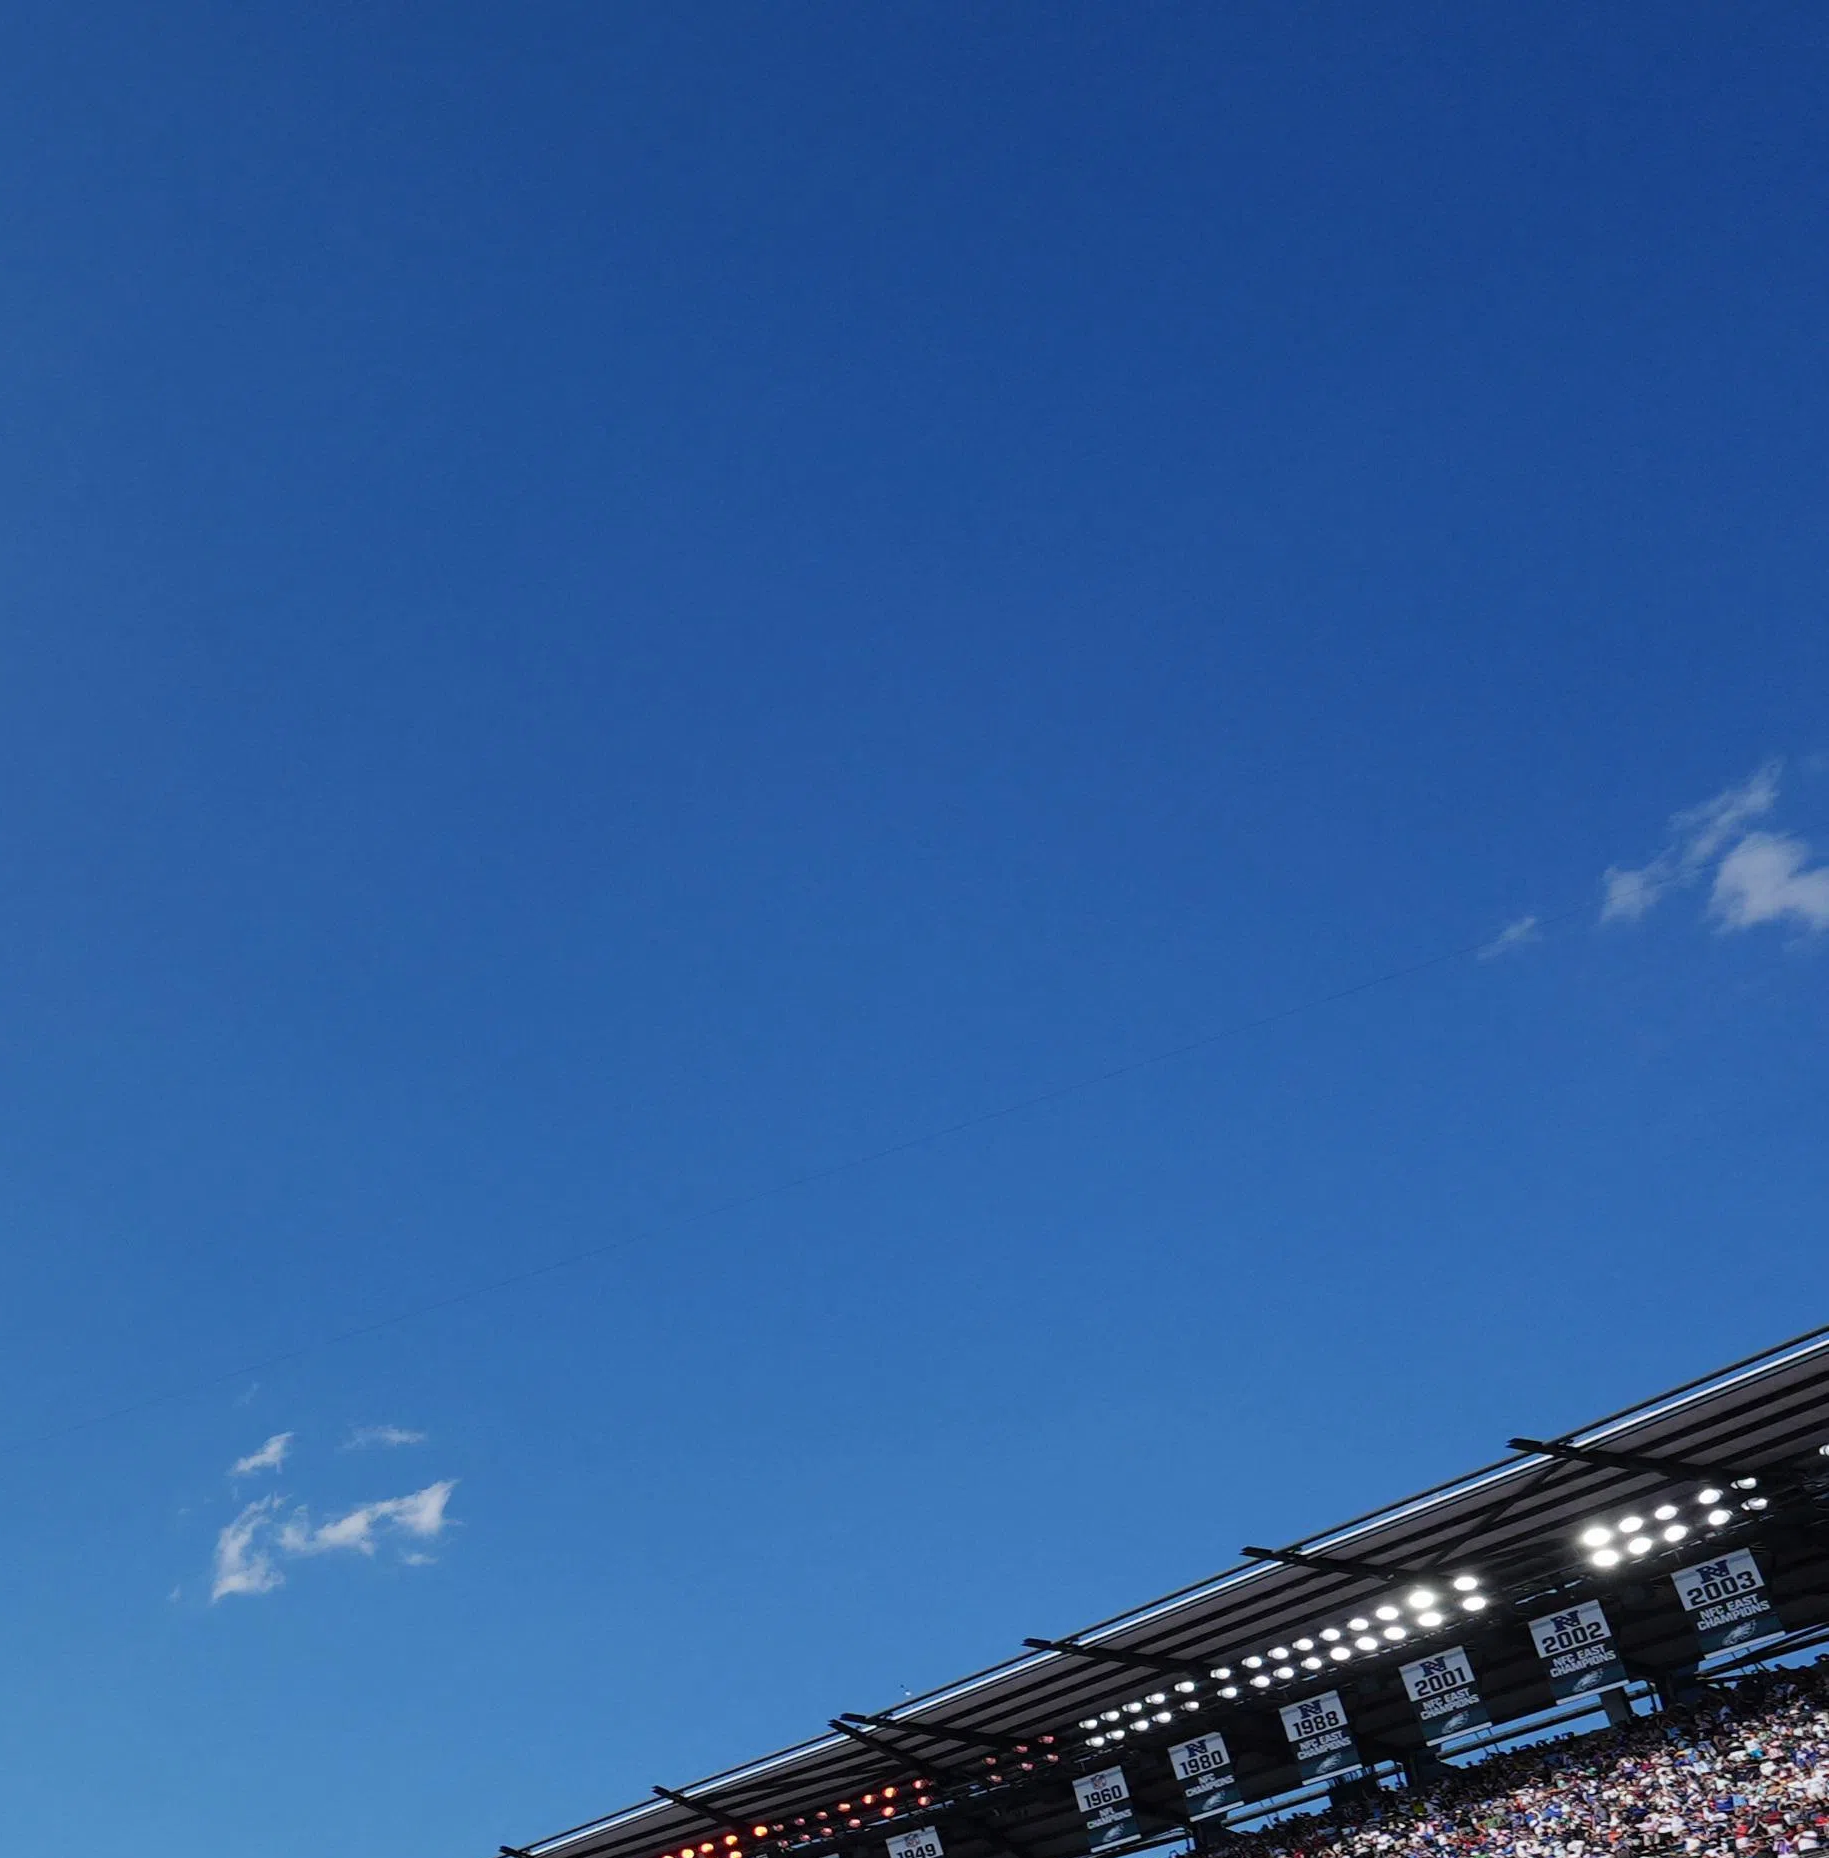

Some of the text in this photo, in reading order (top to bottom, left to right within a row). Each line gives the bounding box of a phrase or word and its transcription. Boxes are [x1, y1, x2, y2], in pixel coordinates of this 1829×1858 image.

[1686, 1570, 1757, 1606] 2003
[1697, 1600, 1771, 1631] CHAMPIONS
[1699, 1593, 1760, 1620] NFC EAST
[1542, 1622, 1606, 1653] 2002
[1549, 1650, 1617, 1678] CHAMPIONS
[1552, 1644, 1606, 1668] NFC EAST
[1414, 1667, 1467, 1697] 2001
[1420, 1694, 1480, 1721] CHAMPIONS
[1422, 1687, 1471, 1712] NFC EAST
[1293, 1710, 1340, 1737] 1988
[1296, 1737, 1352, 1761] CHAMPIONS
[1299, 1730, 1343, 1751] NFC EAST
[1179, 1749, 1224, 1776] 1980
[1083, 1784, 1123, 1809] 1960
